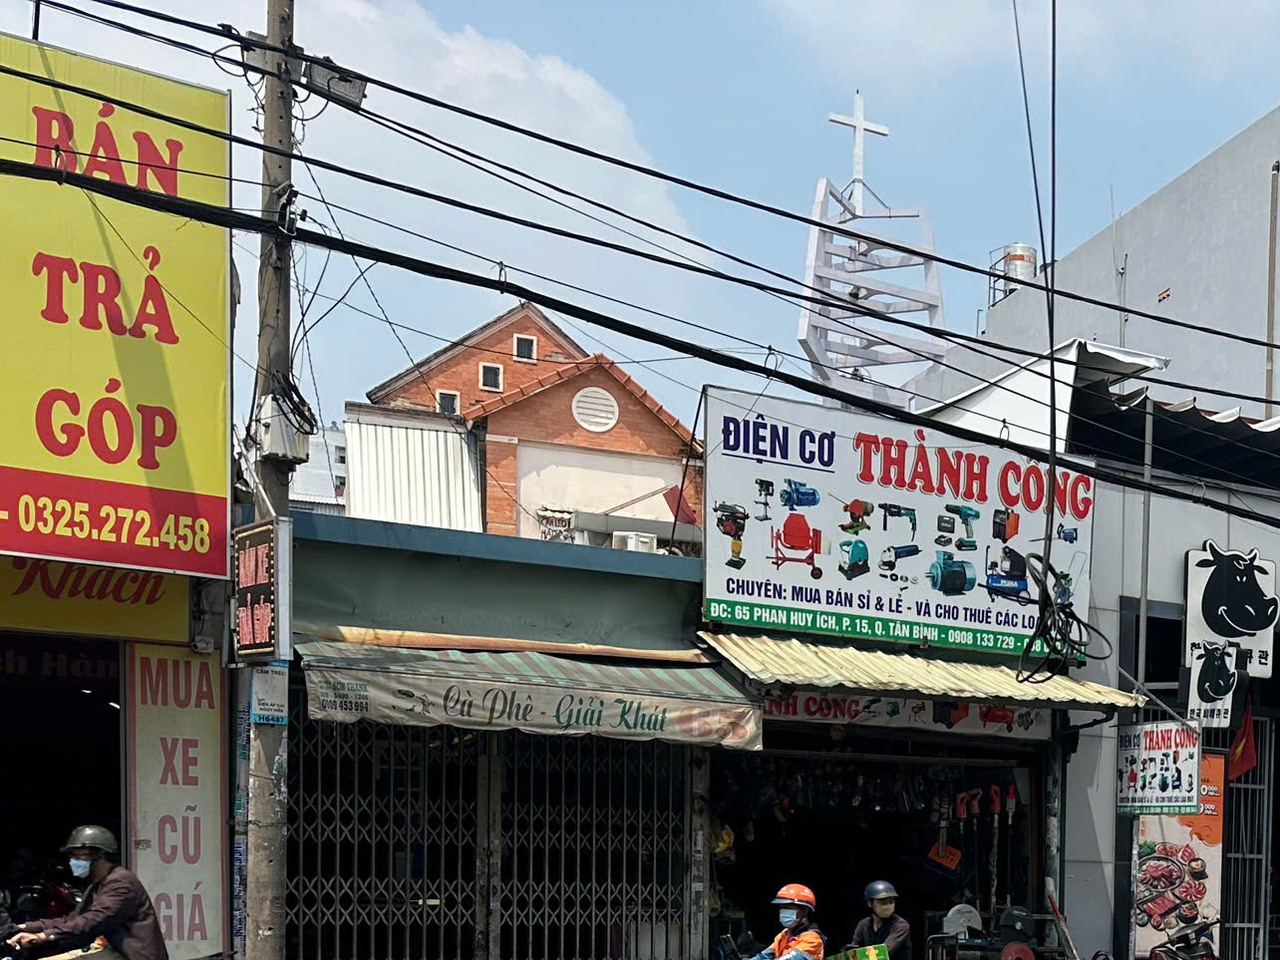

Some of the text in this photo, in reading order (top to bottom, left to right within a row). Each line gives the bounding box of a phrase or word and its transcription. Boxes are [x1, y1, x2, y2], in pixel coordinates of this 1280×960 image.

[31, 102, 183, 198] BÁN
[32, 246, 179, 345] TRẢ
[35, 379, 177, 470] GÓP
[722, 414, 789, 465] ĐIỆN
[799, 429, 836, 468] CƠ
[854, 429, 990, 504] THÀNH
[18, 499, 210, 553] 0325.272.458
[710, 602, 731, 618] ĐC:
[735, 605, 750, 621] 65
[754, 607, 787, 624] PHAN
[790, 611, 813, 627] HUY
[816, 612, 839, 631] ÍCH,
[842, 617, 851, 632] P.
[855, 619, 872, 635] 15,
[874, 621, 885, 635] Q.
[888, 622, 910, 637] TÂN
[912, 625, 939, 641] BÌNH
[948, 630, 973, 645] 0908
[976, 633, 994, 647] 133
[997, 635, 1015, 649] 729
[726, 578, 787, 600] CHUYÊN:
[791, 586, 822, 604] MUA
[826, 583, 853, 608] BÁN
[858, 589, 871, 610] SỈ
[874, 597, 884, 611] &
[888, 594, 903, 613] LẺ
[916, 599, 931, 618] VÀ
[935, 603, 959, 621] CHO
[963, 606, 992, 624] THUÊ
[995, 609, 1019, 628] CÁC
[140, 656, 215, 709] MUA
[443, 684, 473, 719] Cà
[482, 688, 535, 725] Phê
[553, 693, 604, 732] Giải
[610, 698, 668, 732] Khát
[159, 737, 199, 786] XE
[1144, 725, 1172, 750] THÀNH
[157, 805, 201, 865] CŨ
[156, 882, 208, 942] GIÁ
